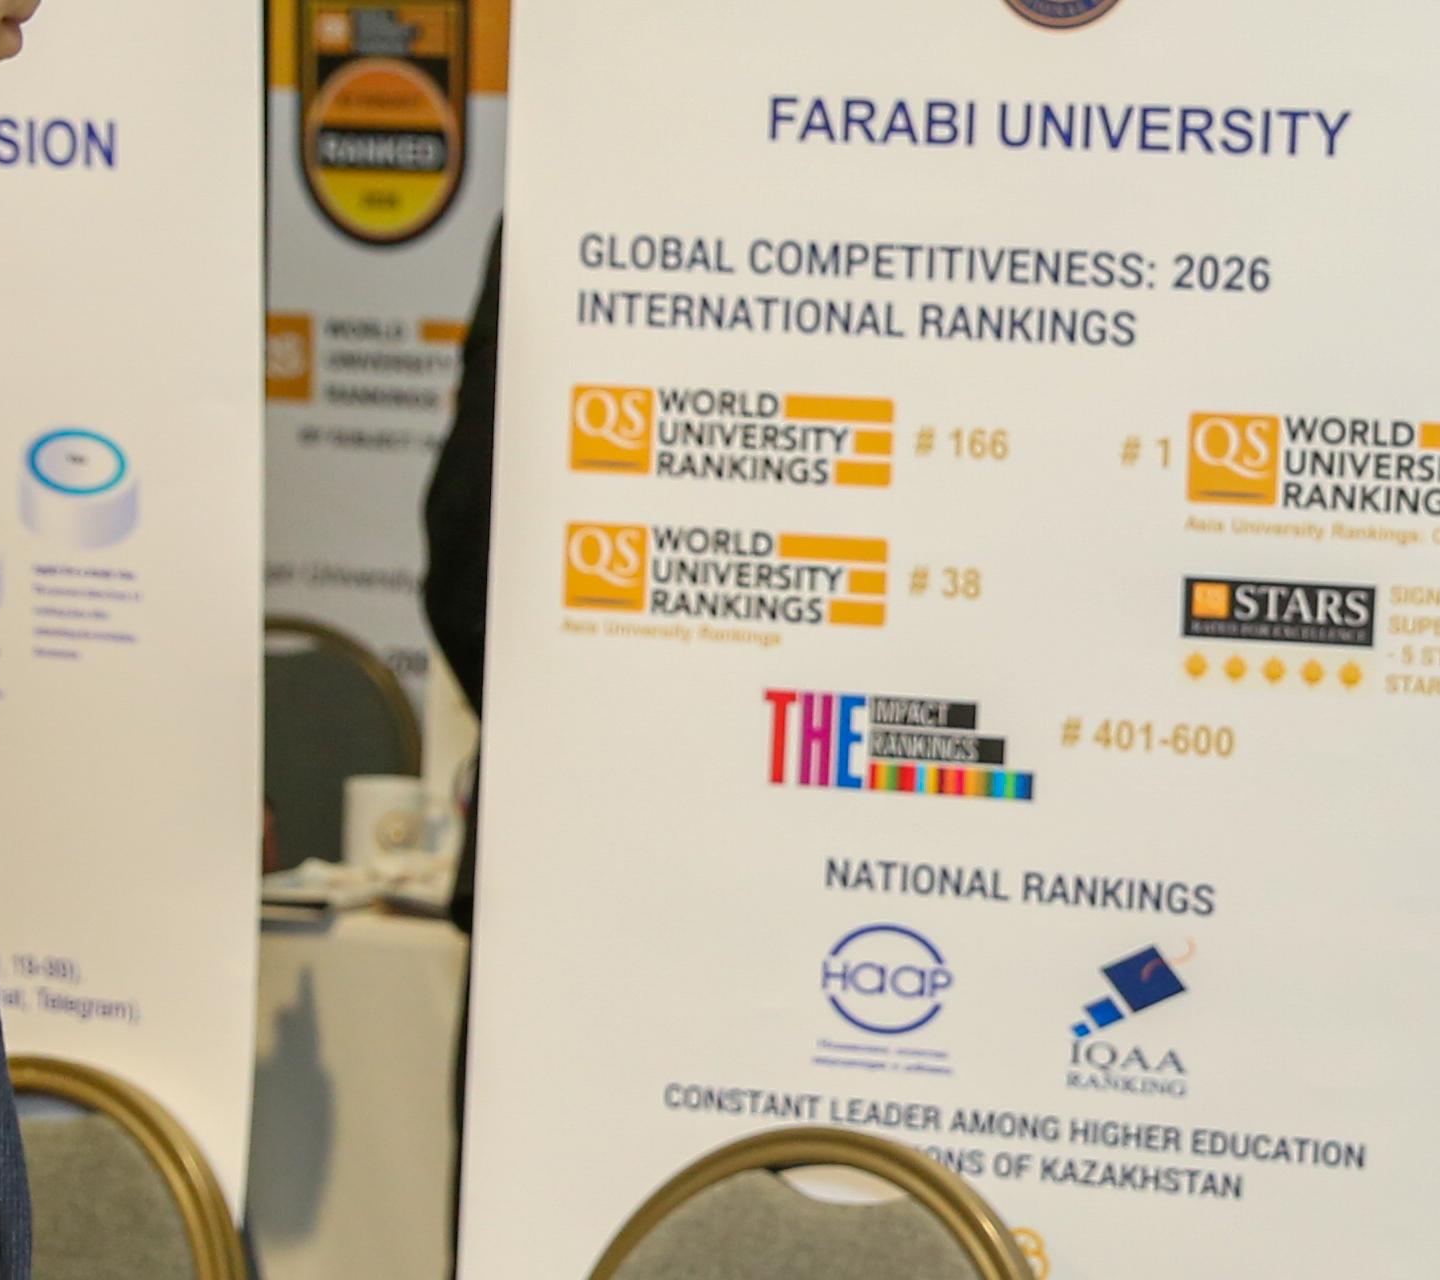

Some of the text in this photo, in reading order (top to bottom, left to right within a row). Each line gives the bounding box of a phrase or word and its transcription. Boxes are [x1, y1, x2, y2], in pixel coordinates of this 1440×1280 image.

[769, 96, 1351, 156] FARABI UNIVERSITY
[579, 233, 1271, 293] GLOBAL COMPETITIVENESS: 2026
[577, 290, 1136, 346] INTERNATIONAL RANKINGS
[574, 388, 779, 450] QS WORLD
[659, 422, 848, 454] UNIVERSITY
[950, 428, 1009, 460] 166
[1193, 416, 1415, 478] QS WORLD
[657, 452, 829, 485] RANKINGS
[1185, 516, 1225, 533] Asia
[1232, 518, 1325, 542] University
[568, 525, 773, 588] QS WORLD
[652, 560, 842, 591] UNIVERSITY
[942, 567, 982, 600] 38
[651, 590, 823, 624] RANKINGS
[1234, 584, 1368, 627] STARS
[763, 688, 867, 790] THE
[1094, 720, 1236, 758] 401-600
[826, 858, 1216, 917] NATIONAL RANKINGS
[1070, 1038, 1188, 1075] IQAA
[1066, 1071, 1188, 1098] RANKING
[664, 1082, 1366, 1170] CONSTANT LEADER AMONG HIGHER EDUCATION
[993, 1151, 1031, 1180] OF
[1041, 1157, 1243, 1200] KAZAKHSTAN
